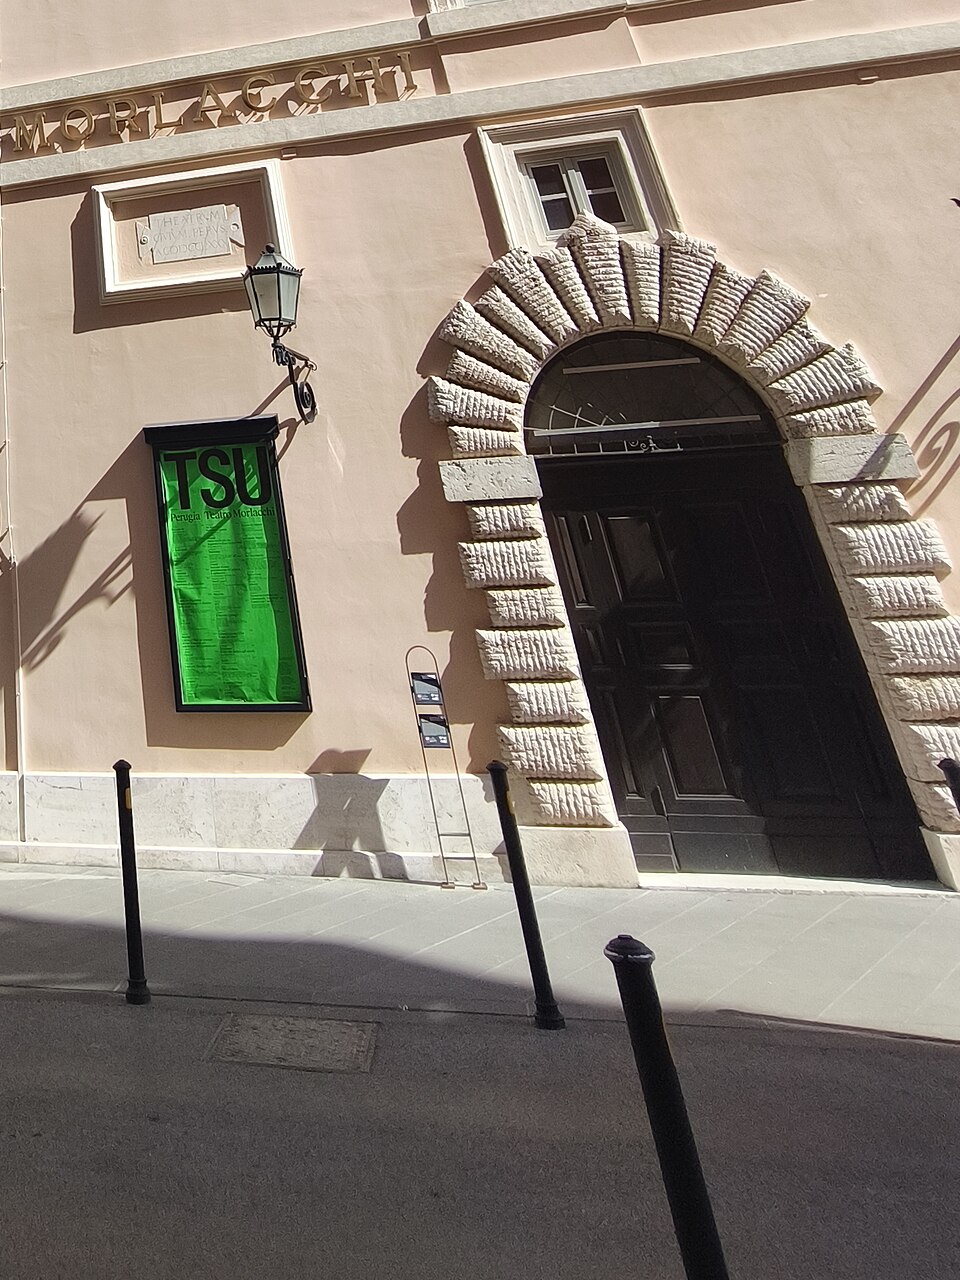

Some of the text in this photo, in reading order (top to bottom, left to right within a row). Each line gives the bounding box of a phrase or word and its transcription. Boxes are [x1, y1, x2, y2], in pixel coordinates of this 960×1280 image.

[12, 52, 418, 153] MORLACCHI
[163, 446, 273, 510] TSU
[171, 506, 276, 523] Perugia Teatro Morlacchi
